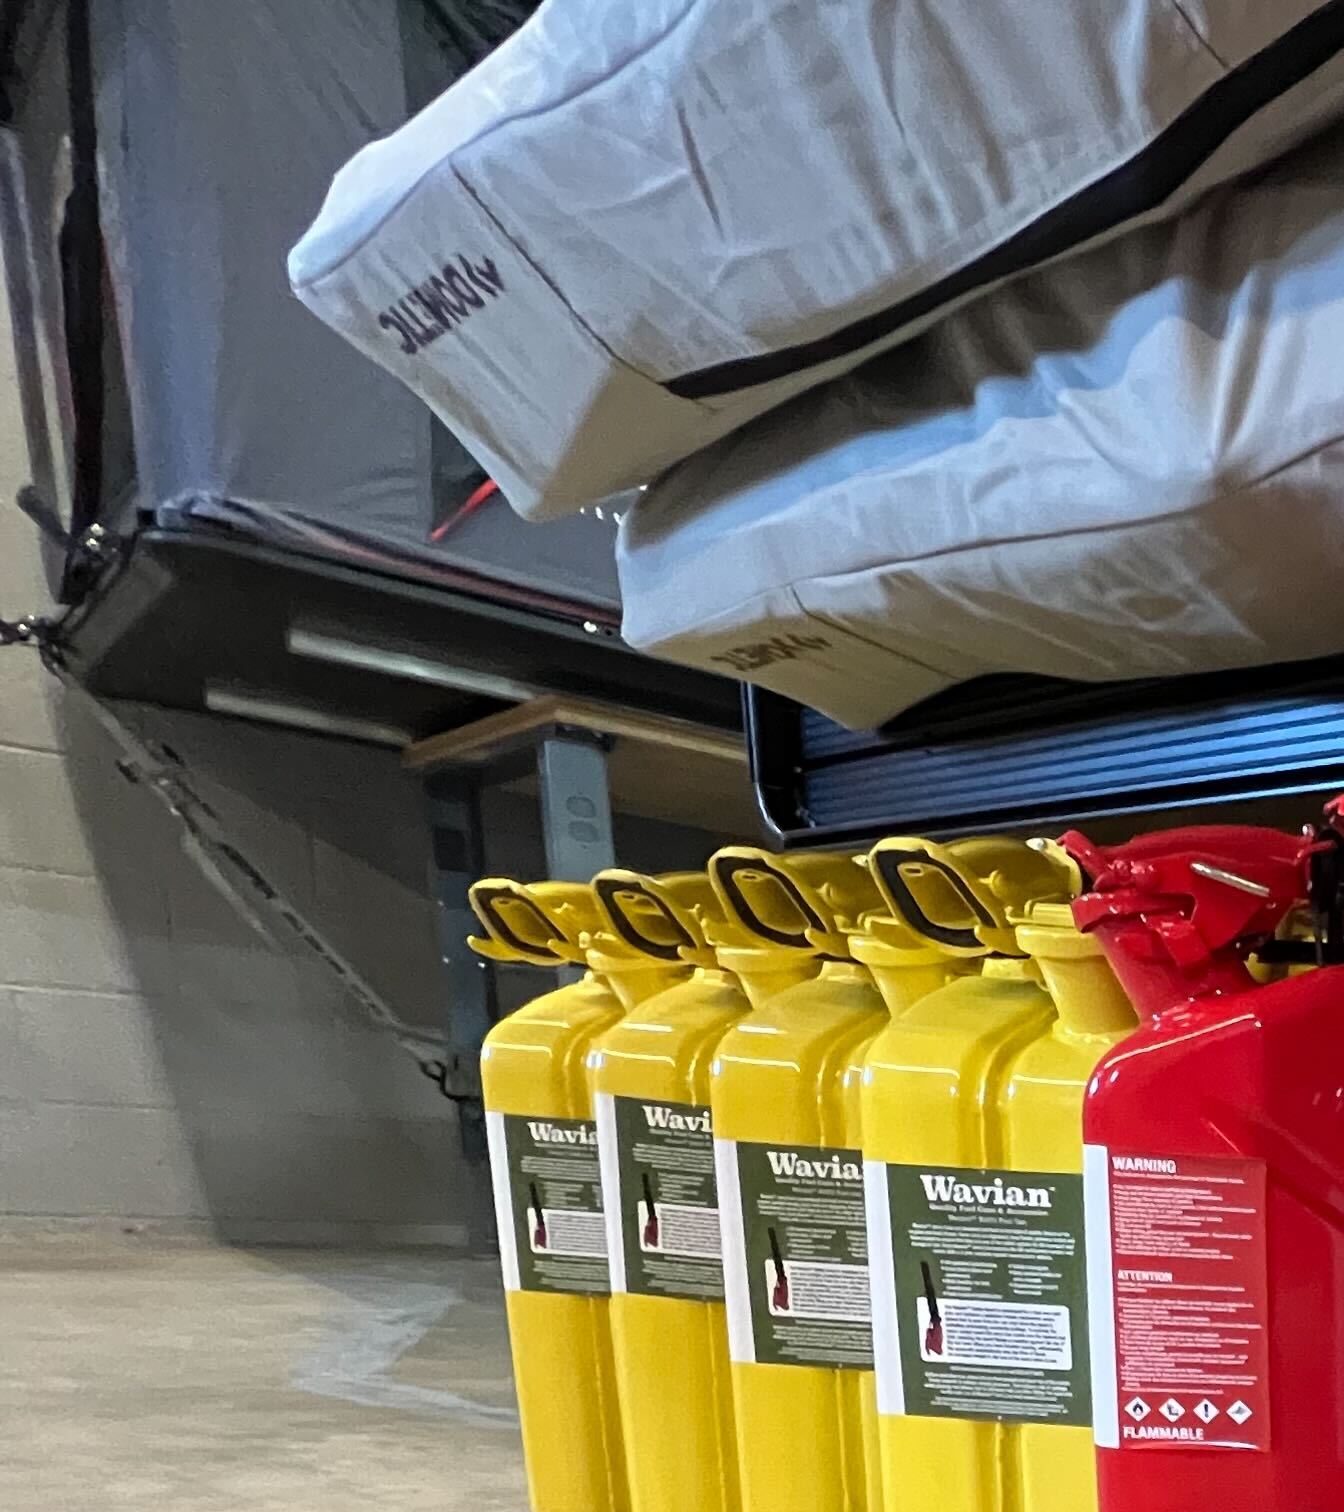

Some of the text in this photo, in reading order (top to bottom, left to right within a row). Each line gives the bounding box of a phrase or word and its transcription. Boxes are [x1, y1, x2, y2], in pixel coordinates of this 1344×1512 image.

[642, 1105, 712, 1133] Wavi
[527, 1122, 598, 1145] Wavia
[766, 1151, 863, 1180] Wavia
[1112, 1156, 1177, 1174] WARNING
[920, 1174, 1052, 1208] Wavian
[1117, 1270, 1173, 1283] ATTENTION
[1123, 1426, 1204, 1441] FLAMMABLE
